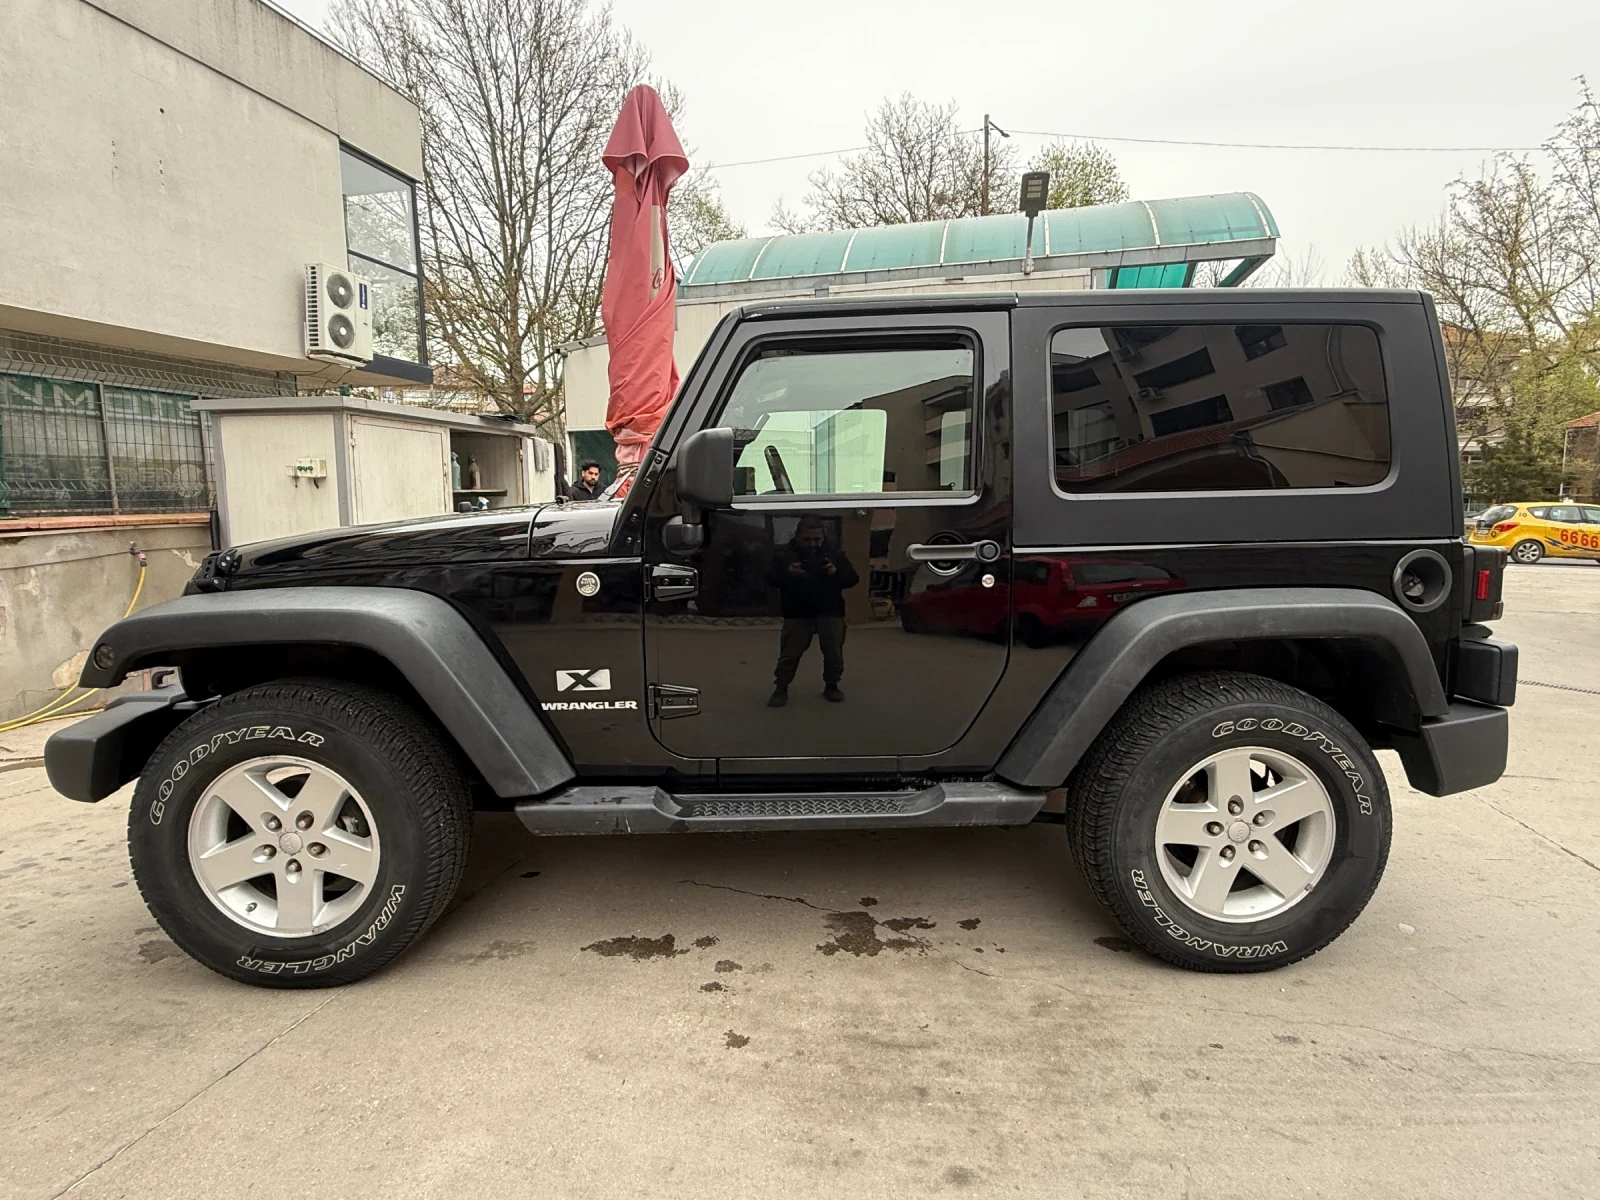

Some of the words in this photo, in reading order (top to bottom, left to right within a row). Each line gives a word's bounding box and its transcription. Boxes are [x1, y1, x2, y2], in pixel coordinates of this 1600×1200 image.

[1560, 529, 1599, 548] 6666
[541, 701, 638, 710] WRANGLER
[150, 726, 324, 825] GOODYEAR
[1212, 718, 1372, 816] GOODYEAR
[236, 884, 405, 974] WRANGLER
[1131, 869, 1288, 958] WRANGLER
